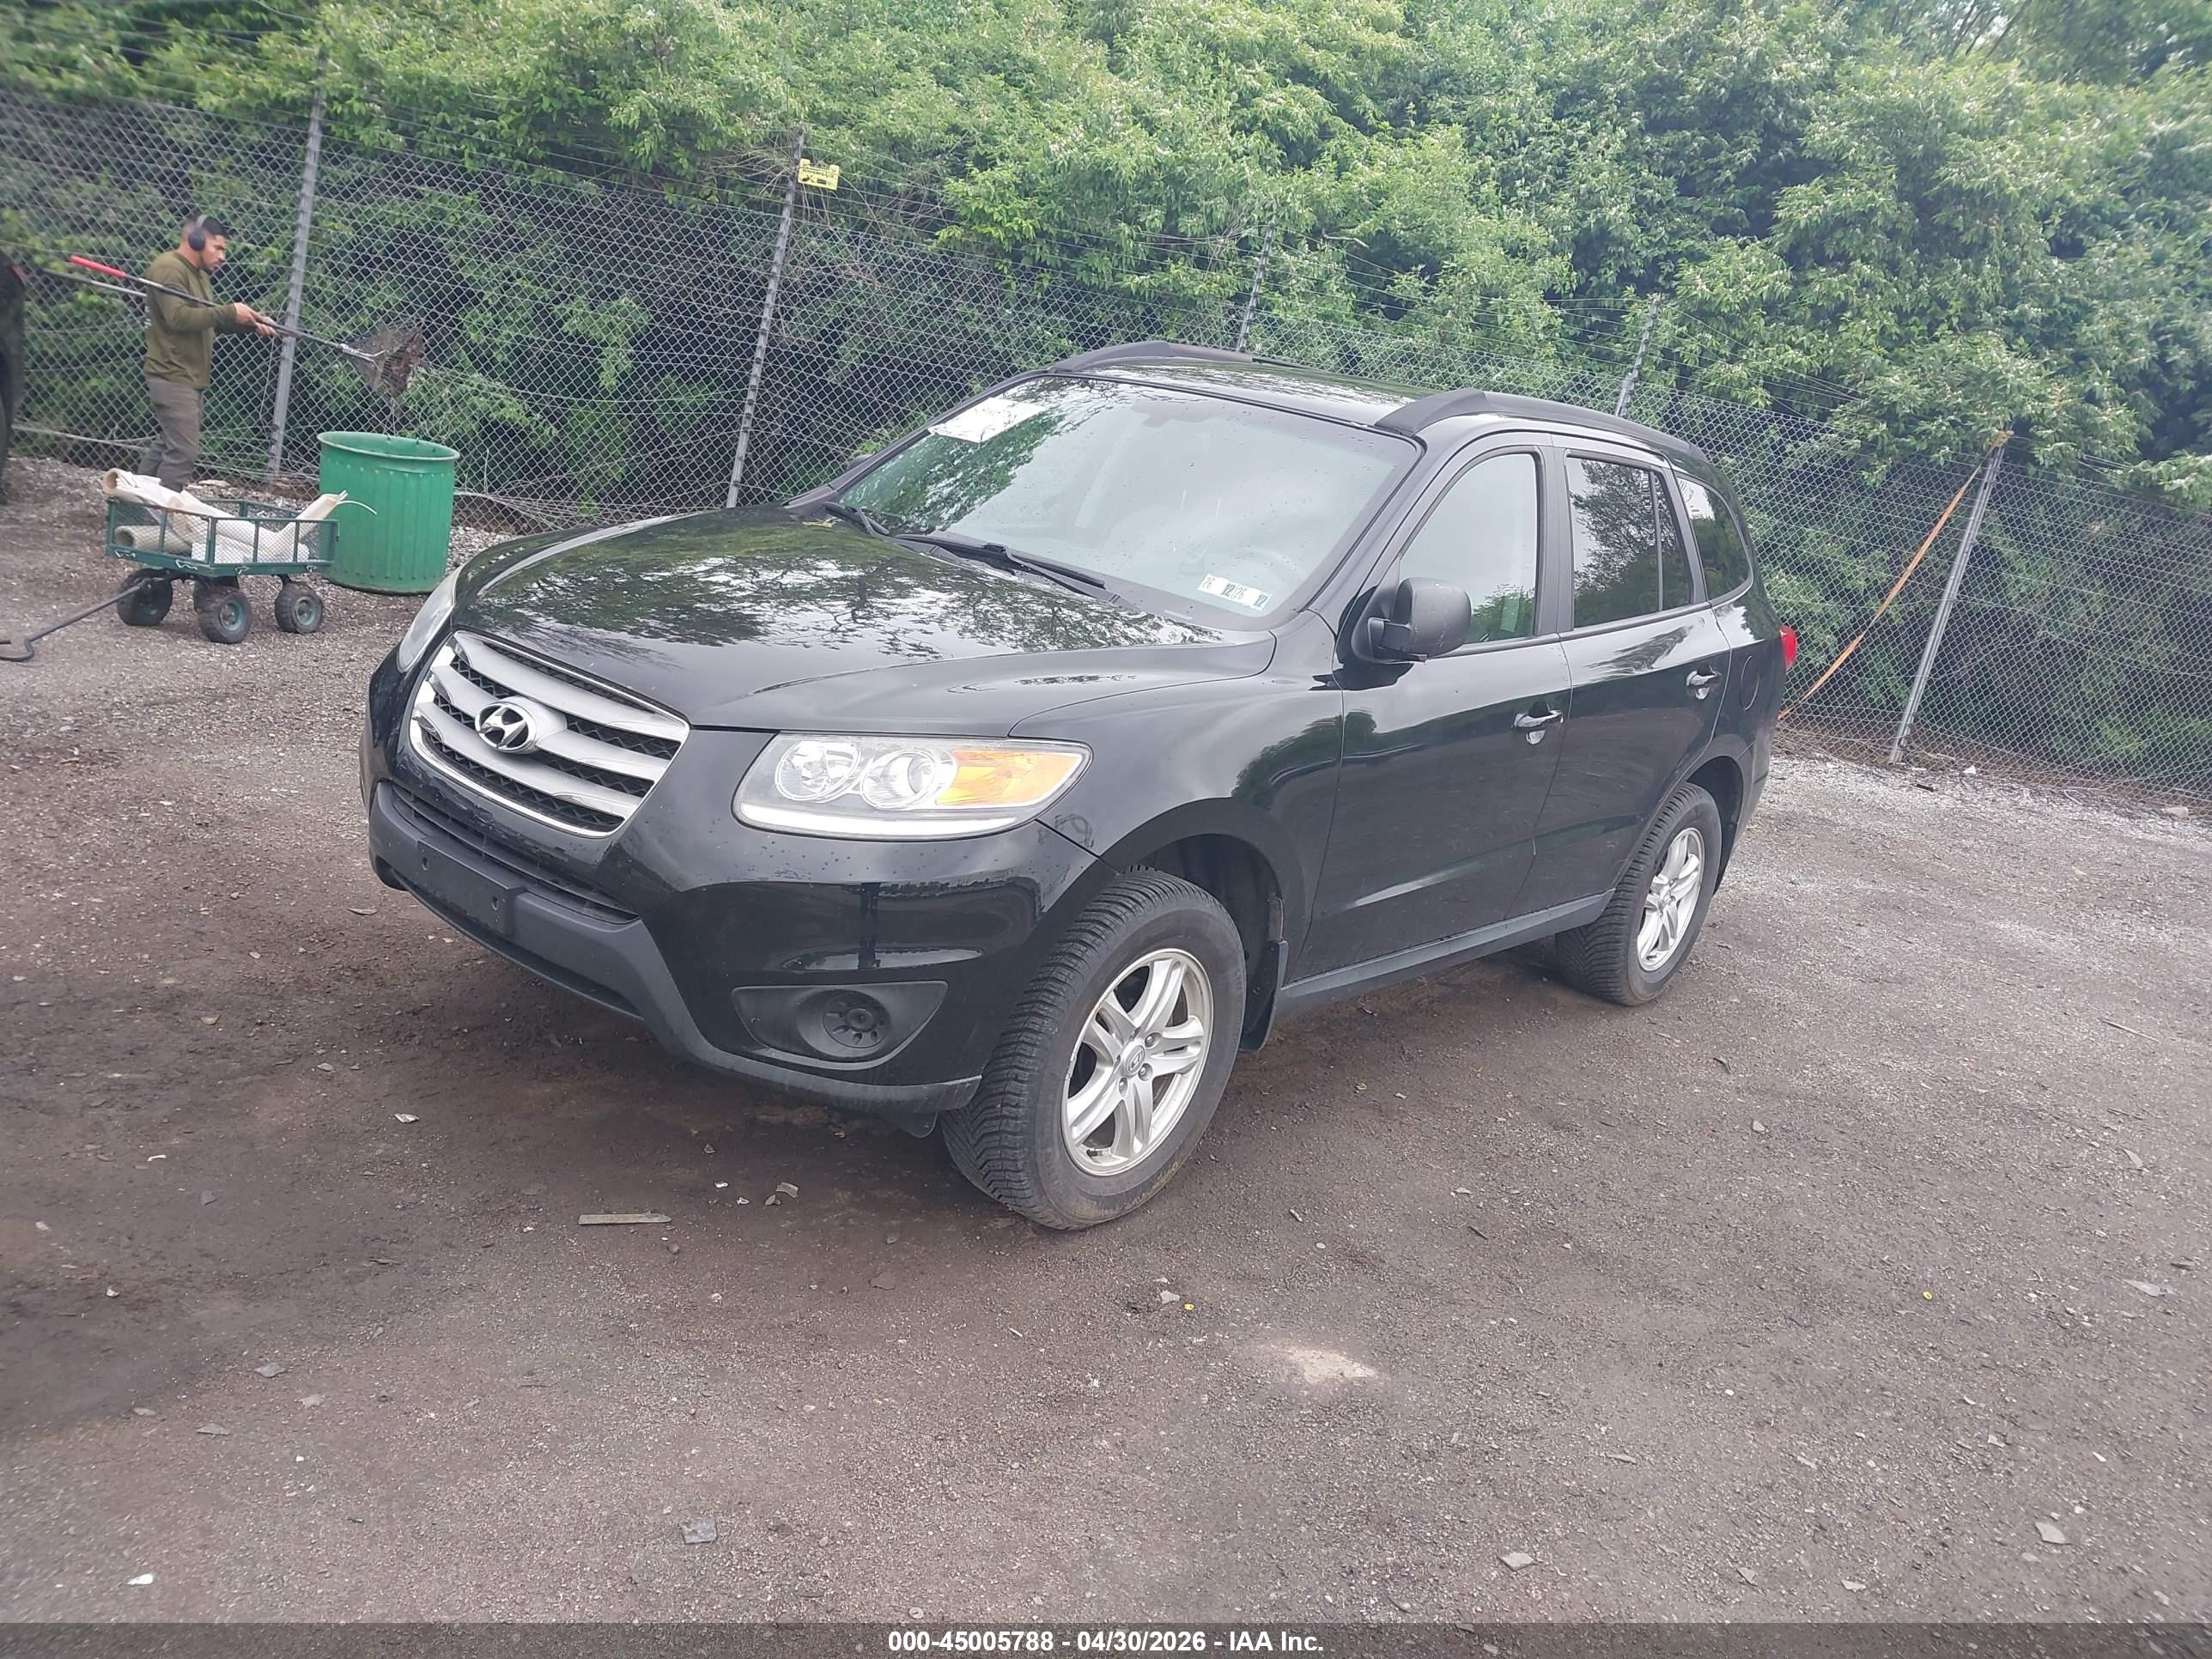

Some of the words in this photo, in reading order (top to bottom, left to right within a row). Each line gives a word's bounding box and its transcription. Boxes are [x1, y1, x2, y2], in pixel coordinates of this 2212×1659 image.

[1220, 583, 1236, 598] 12
[1234, 587, 1248, 599] 26
[1254, 594, 1268, 607] 12
